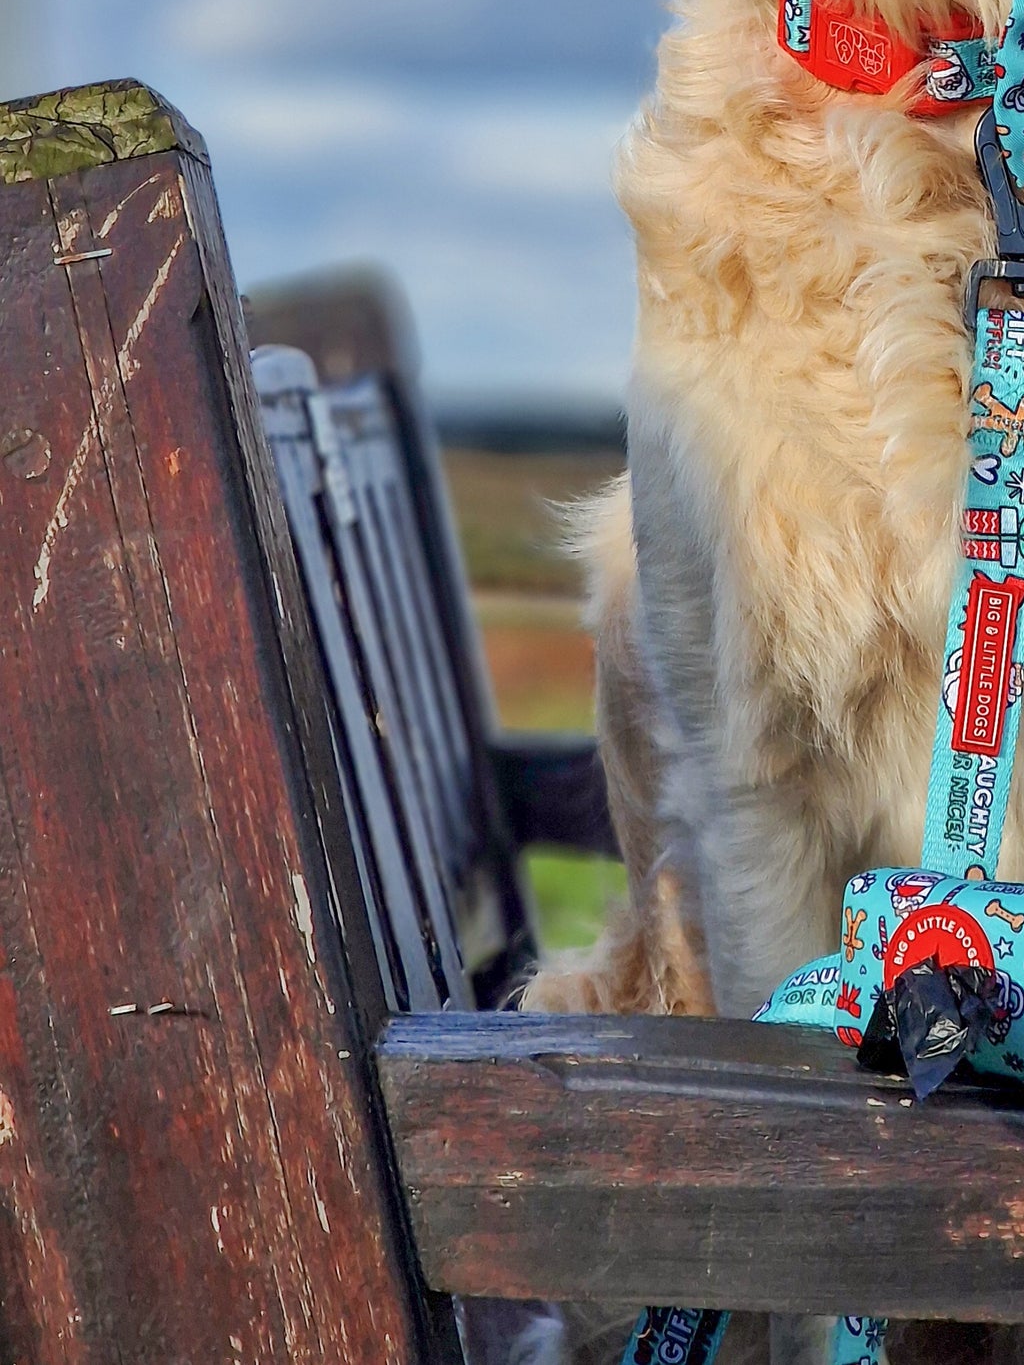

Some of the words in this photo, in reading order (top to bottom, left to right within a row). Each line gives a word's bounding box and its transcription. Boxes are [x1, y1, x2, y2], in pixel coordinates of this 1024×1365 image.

[985, 596, 1002, 621] BIG
[979, 640, 997, 690] LITTLE
[973, 694, 992, 738] DOGS
[944, 776, 969, 842] NICE!
[966, 754, 998, 858] AUGHTY
[893, 940, 909, 965] BIG
[916, 916, 956, 934] LITTLE
[955, 926, 980, 967] DOGS
[784, 988, 817, 1005] OR
